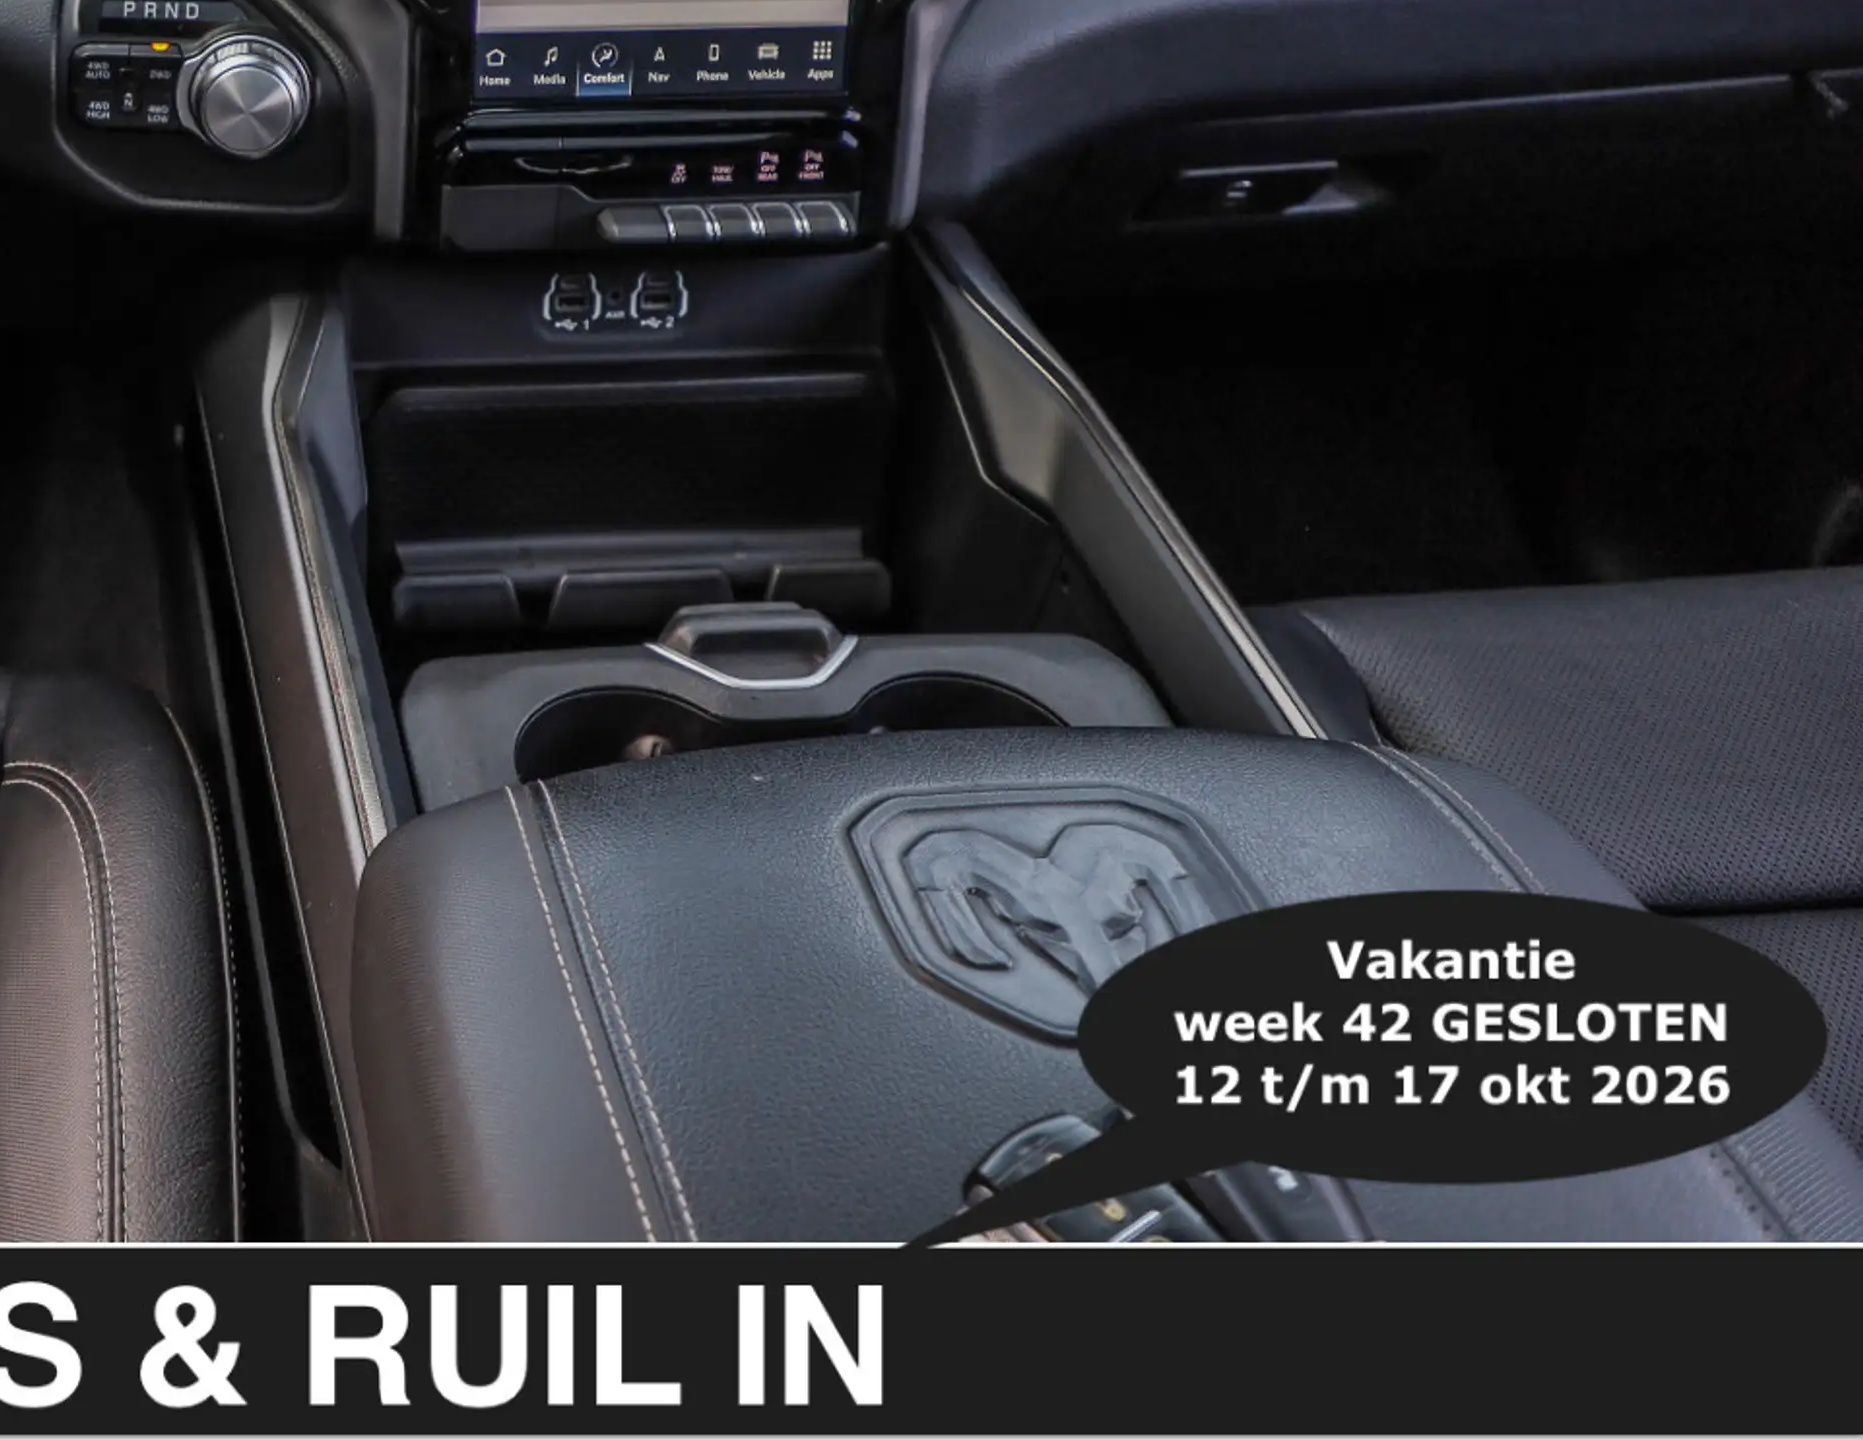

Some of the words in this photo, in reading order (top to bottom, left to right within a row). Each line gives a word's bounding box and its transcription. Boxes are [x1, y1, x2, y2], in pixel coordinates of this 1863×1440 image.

[124, 1, 136, 17] P
[144, 2, 157, 18] R
[165, 3, 179, 19] N
[186, 3, 200, 19] D
[533, 72, 566, 85] Media
[583, 72, 626, 84] Comfort
[648, 71, 670, 83] Nav
[696, 70, 729, 82] Phone
[747, 69, 786, 81] Vehicle
[807, 67, 834, 81] Apps
[479, 75, 510, 87] Home
[583, 319, 590, 330] 1
[665, 316, 675, 329] 2
